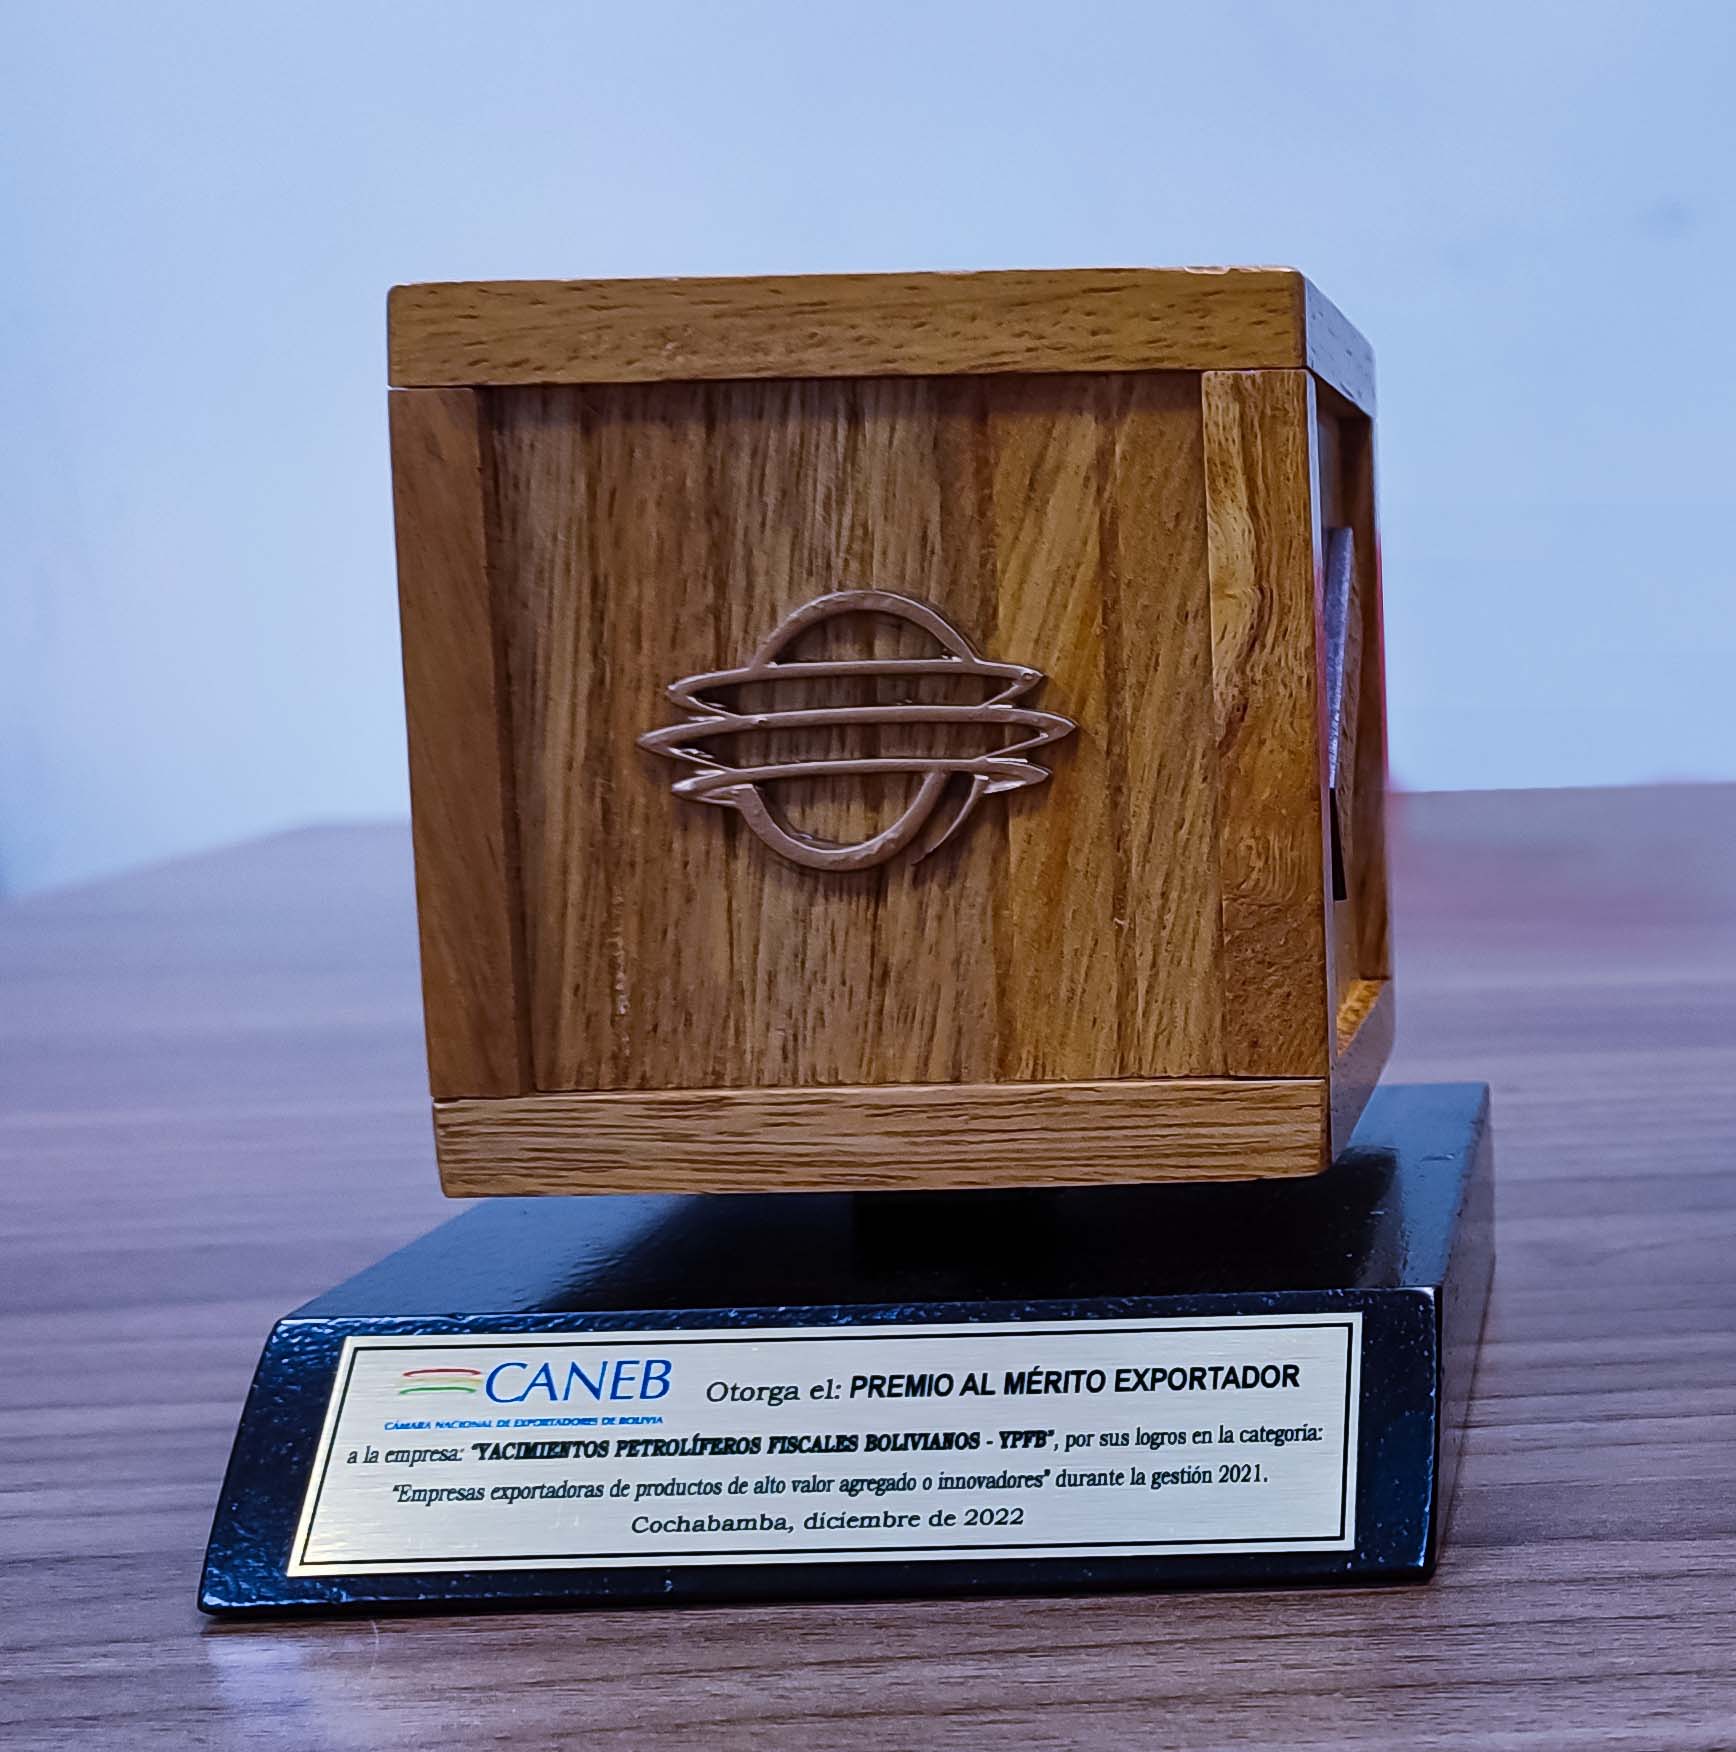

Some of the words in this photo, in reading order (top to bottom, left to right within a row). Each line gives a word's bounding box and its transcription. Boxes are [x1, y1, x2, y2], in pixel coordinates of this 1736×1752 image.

[486, 1359, 672, 1403] CANEB
[707, 1381, 799, 1407] Otorga
[809, 1380, 841, 1401] el:
[850, 1373, 953, 1398] PREMIO
[960, 1373, 995, 1395] AL
[1003, 1366, 1106, 1395] MÉRITO
[1114, 1365, 1300, 1393] EXPORTADOR
[384, 1419, 431, 1431] CÁMARA
[435, 1419, 492, 1429] NACIONAL
[496, 1418, 510, 1428] DE
[514, 1417, 598, 1427] EXPORTADORES
[601, 1417, 615, 1426] DE
[619, 1415, 663, 1425] BOLIVIA
[347, 1450, 358, 1464] a
[363, 1446, 379, 1464] la
[384, 1448, 463, 1468] empresa:
[614, 1434, 761, 1457] PETROLÍFEROS
[767, 1435, 859, 1455] FISCALES
[865, 1432, 980, 1451] BOLIVIANOS
[1064, 1432, 1094, 1453] por
[1099, 1432, 1129, 1447] sus
[1135, 1428, 1187, 1451] logros
[1192, 1429, 1214, 1444] en
[1218, 1425, 1235, 1443] la
[490, 1480, 604, 1504] exportadoras
[609, 1479, 630, 1498] de
[635, 1478, 722, 1501] productos
[727, 1477, 749, 1495] de
[754, 1476, 787, 1494] alto
[791, 1475, 835, 1492] valor
[839, 1472, 916, 1496] agregado
[922, 1477, 932, 1491] o
[1055, 1467, 1124, 1487] durante
[1129, 1466, 1146, 1485] la
[1151, 1465, 1212, 1489] gestión
[1218, 1464, 1269, 1484] 2021.
[631, 1514, 794, 1535] Cochabamba,
[804, 1512, 921, 1530] diciembre
[928, 1509, 957, 1527] de
[964, 1508, 1024, 1526] 2022
